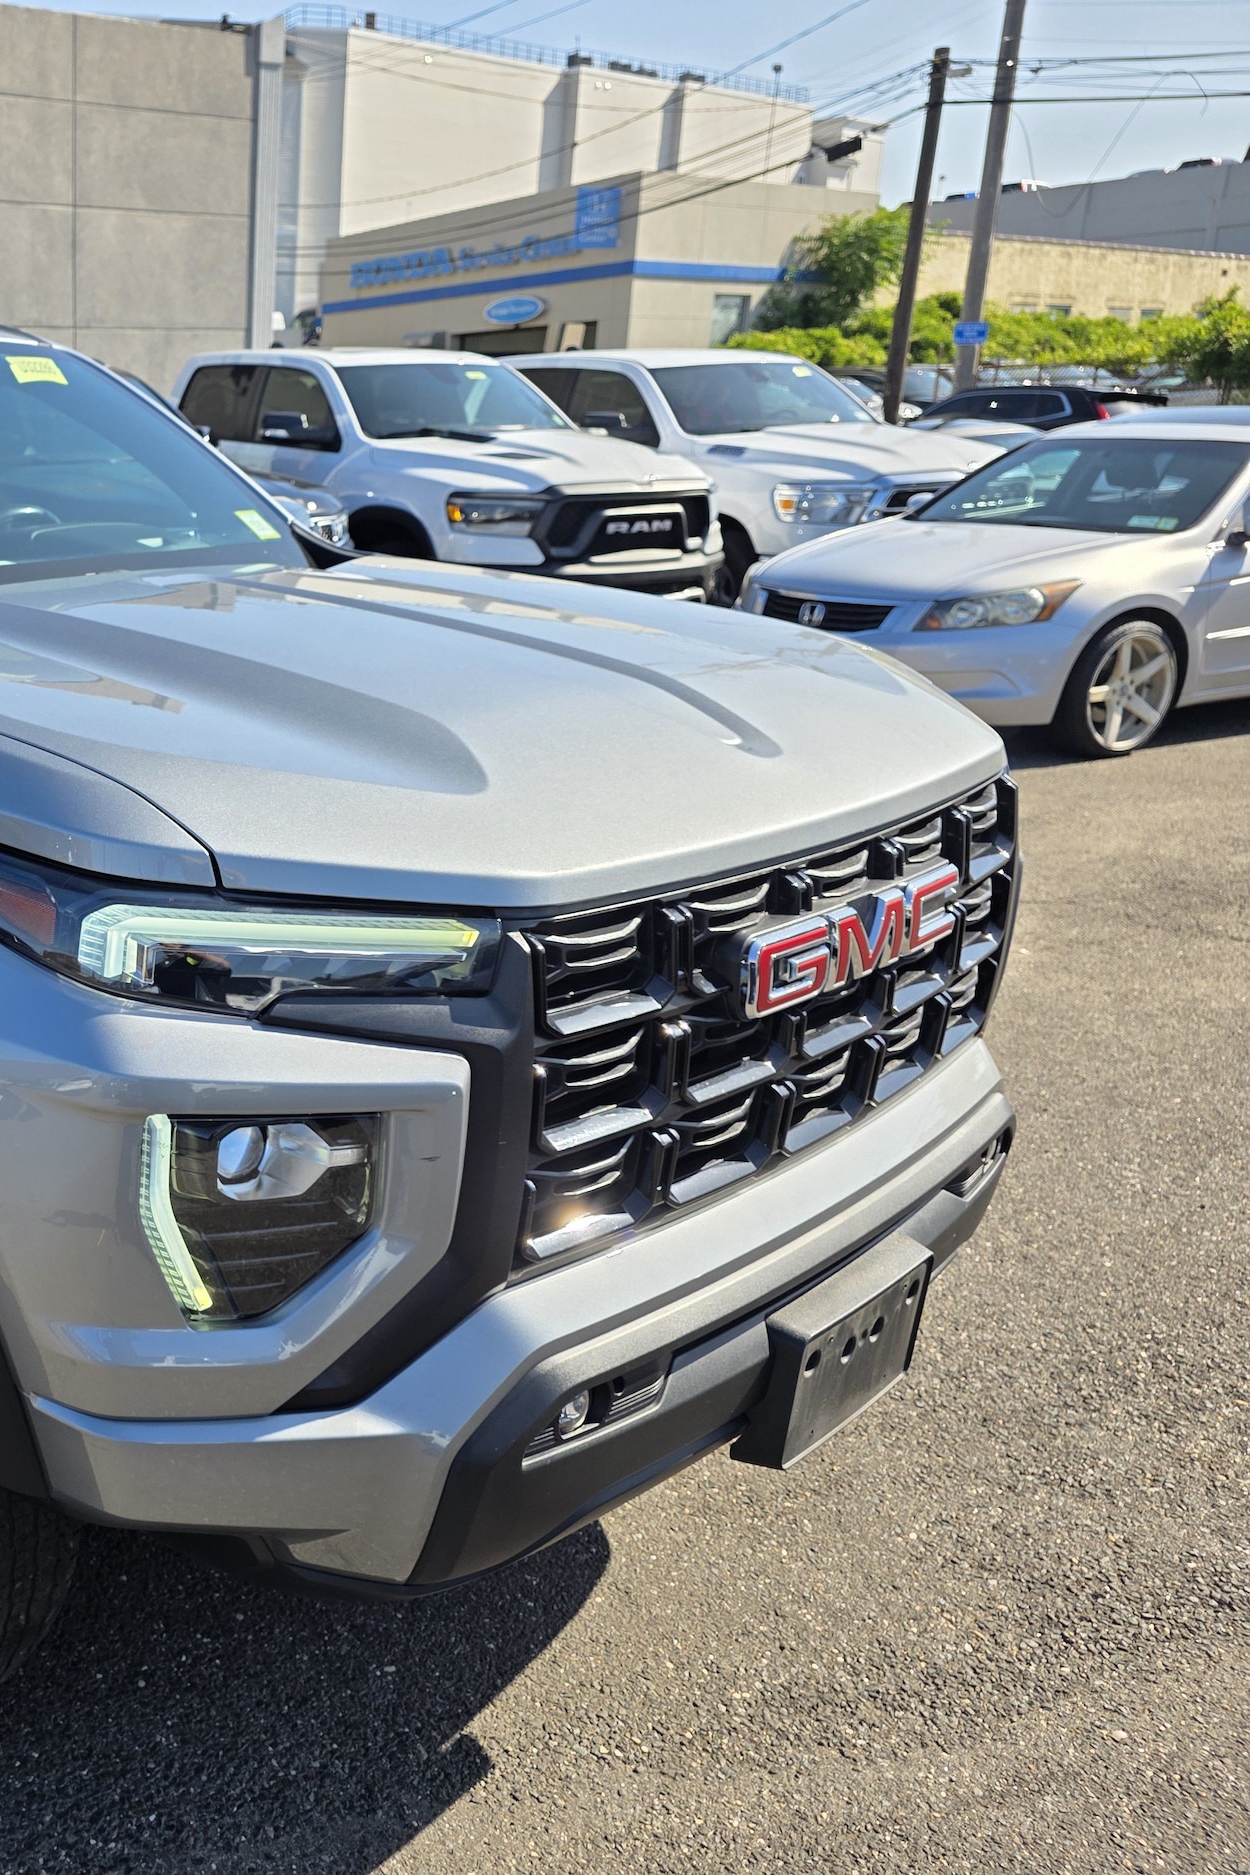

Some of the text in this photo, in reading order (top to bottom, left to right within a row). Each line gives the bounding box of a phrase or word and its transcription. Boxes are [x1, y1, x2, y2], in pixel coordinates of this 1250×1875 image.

[350, 247, 453, 288] HONDA
[605, 518, 674, 535] RAM
[744, 862, 960, 1020] GMC
